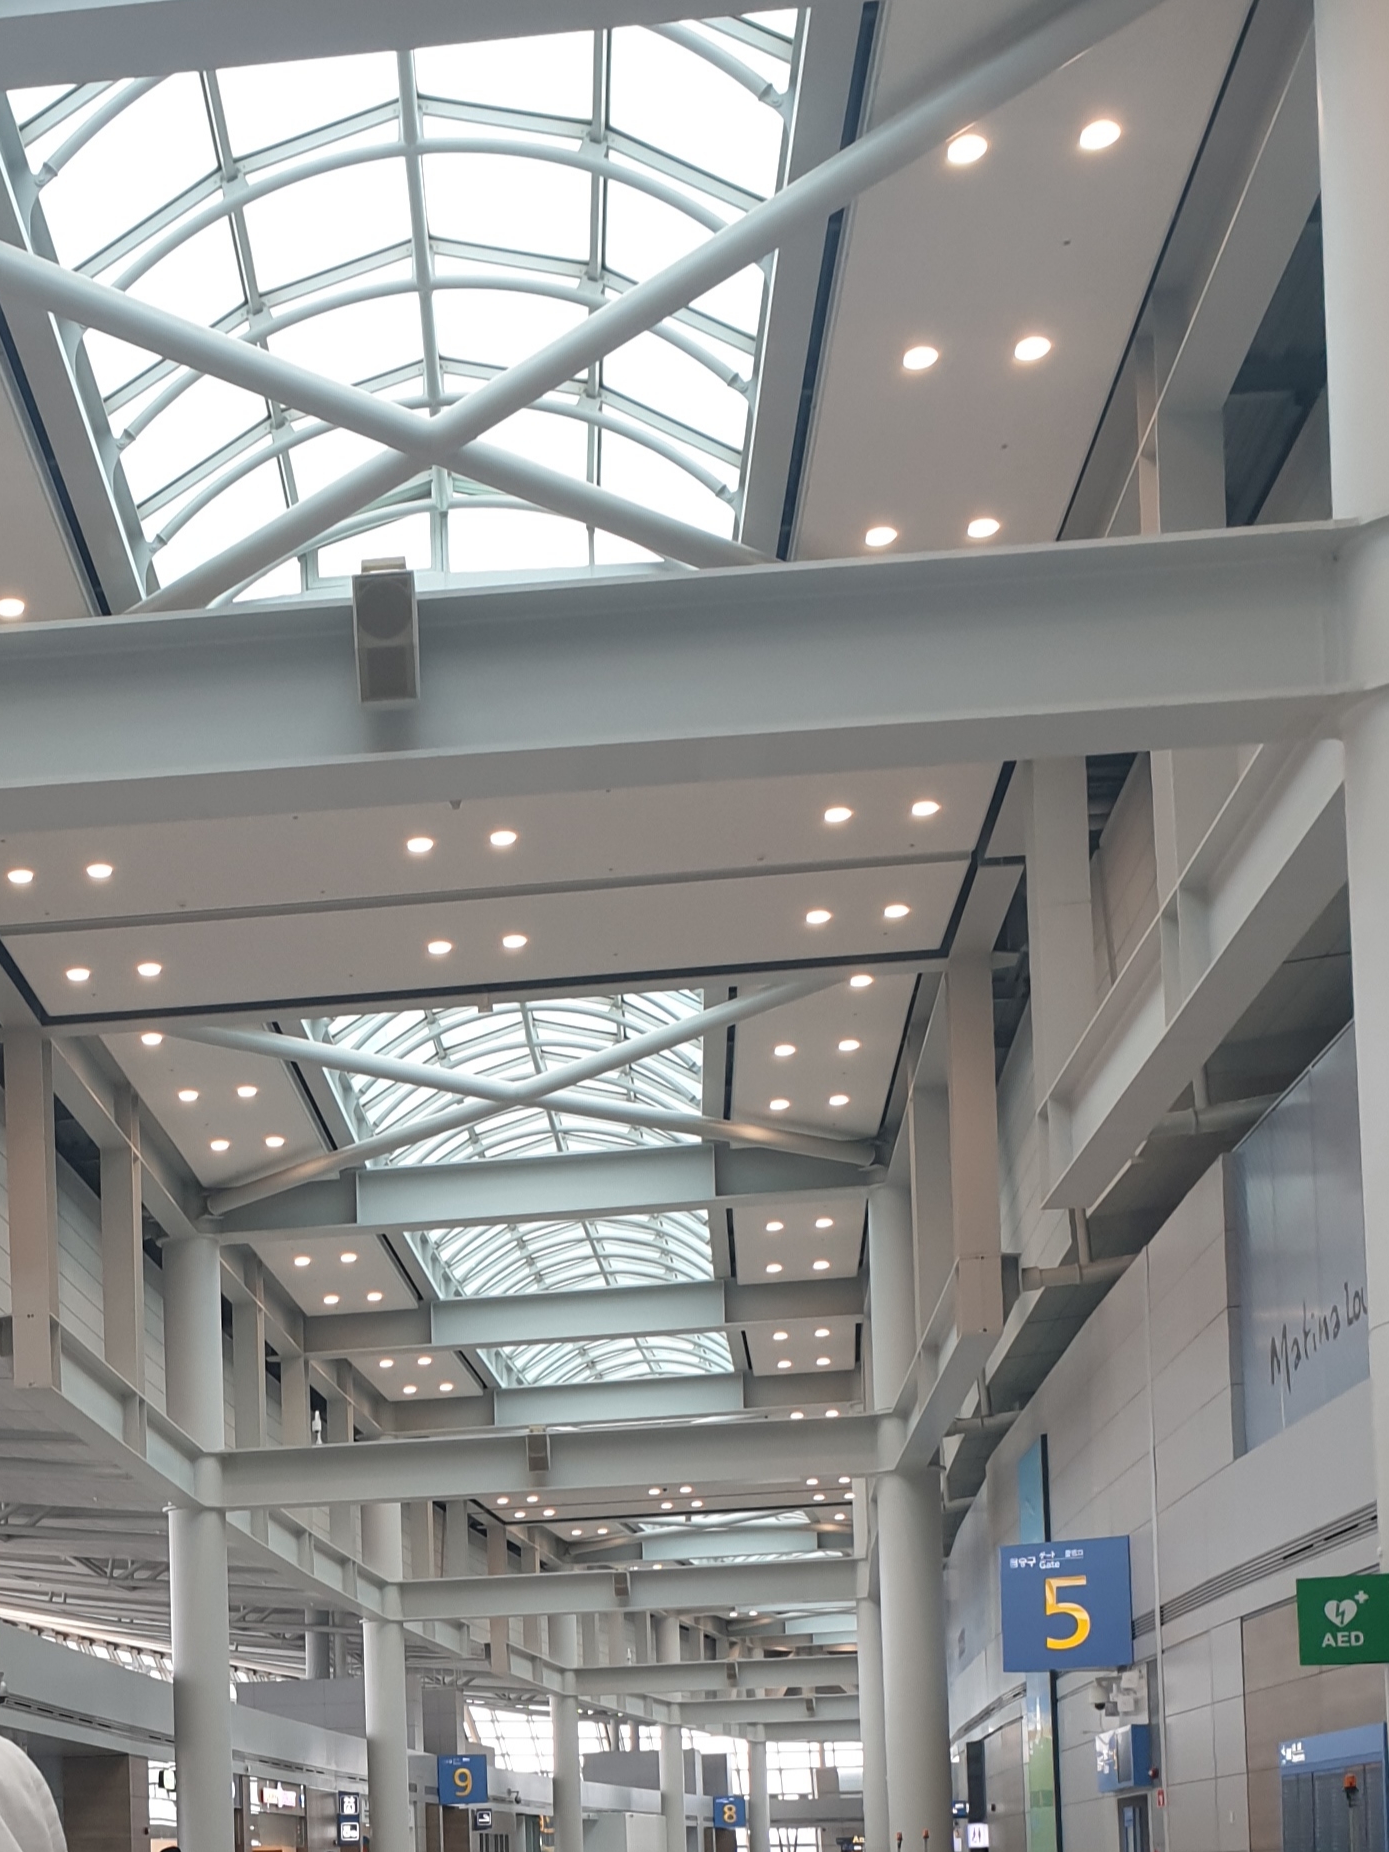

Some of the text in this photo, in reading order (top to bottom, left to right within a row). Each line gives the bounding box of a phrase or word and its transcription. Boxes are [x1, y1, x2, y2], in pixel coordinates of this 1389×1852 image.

[1270, 1300, 1341, 1395] Matina
[1039, 1560, 1060, 1570] Gate
[1044, 1575, 1091, 1650] 5
[1321, 1631, 1364, 1648] AED
[453, 1767, 473, 1797] 9
[723, 1804, 737, 1824] 8
